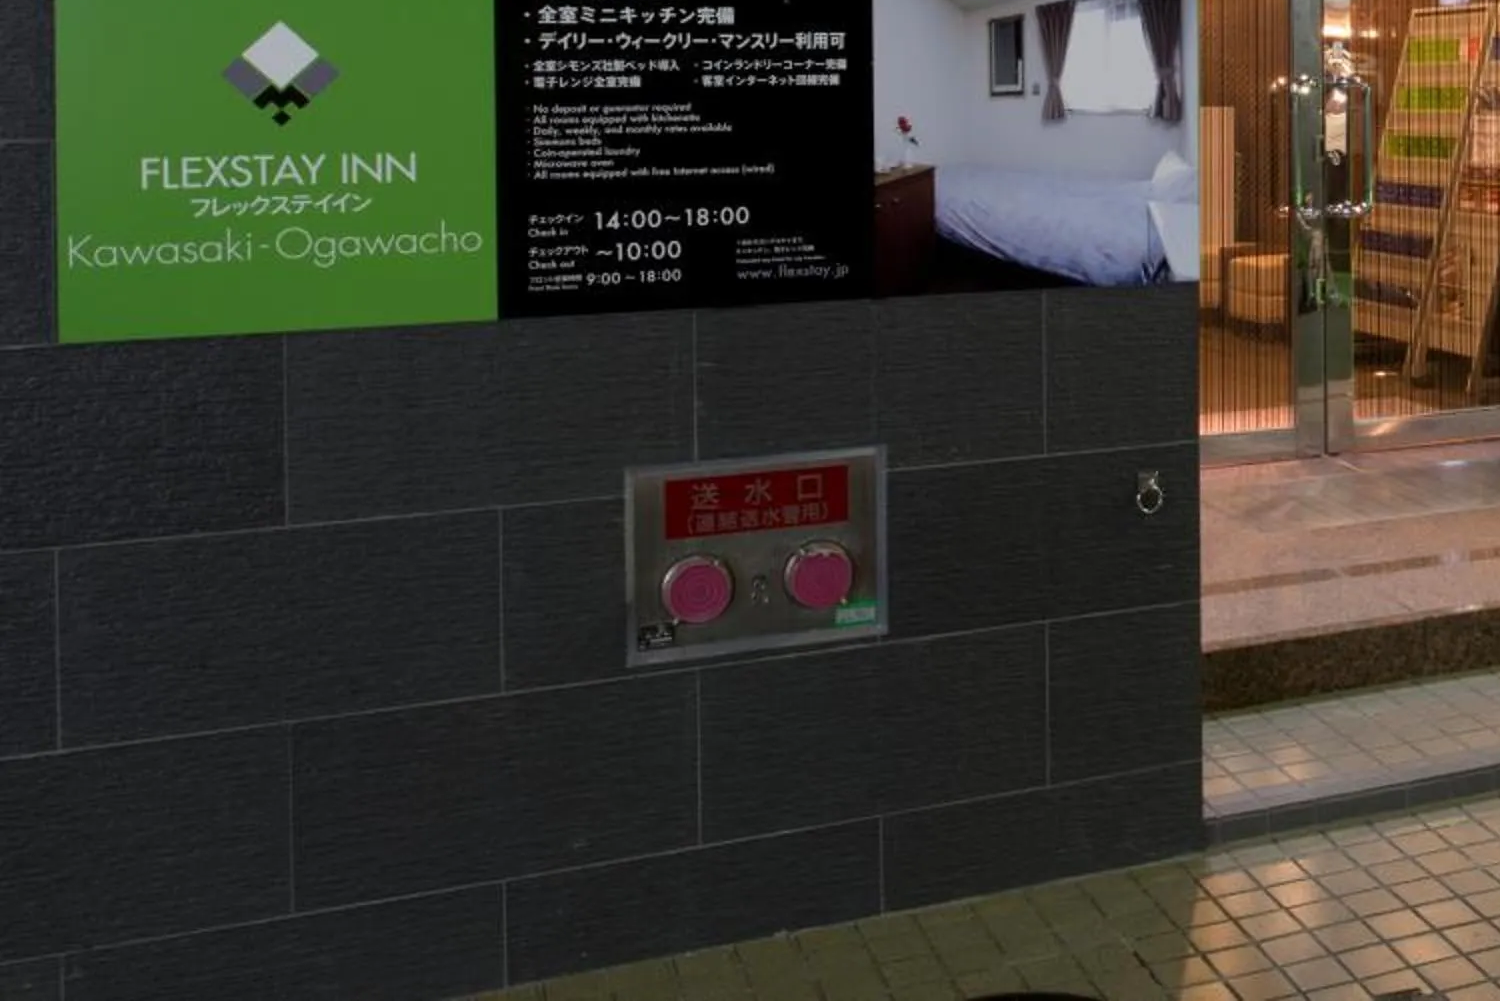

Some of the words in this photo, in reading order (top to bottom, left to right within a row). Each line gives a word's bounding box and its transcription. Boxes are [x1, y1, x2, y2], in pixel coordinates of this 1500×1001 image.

[537, 6, 735, 25] 全室ミニキッチン完備
[533, 104, 548, 114] No
[551, 104, 587, 115] deposit
[651, 102, 692, 115] required
[533, 115, 547, 124] All
[604, 125, 623, 134] and
[626, 123, 662, 135] monthly
[140, 153, 326, 190] FLEXSTAY
[342, 152, 417, 185] INN
[533, 169, 548, 179] All
[190, 192, 373, 218] フレックステイイン
[528, 213, 585, 225] チェックイン
[527, 226, 556, 238] Check
[528, 245, 589, 257] チェックアウト
[527, 259, 556, 270] Check
[690, 474, 823, 510] 送水口
